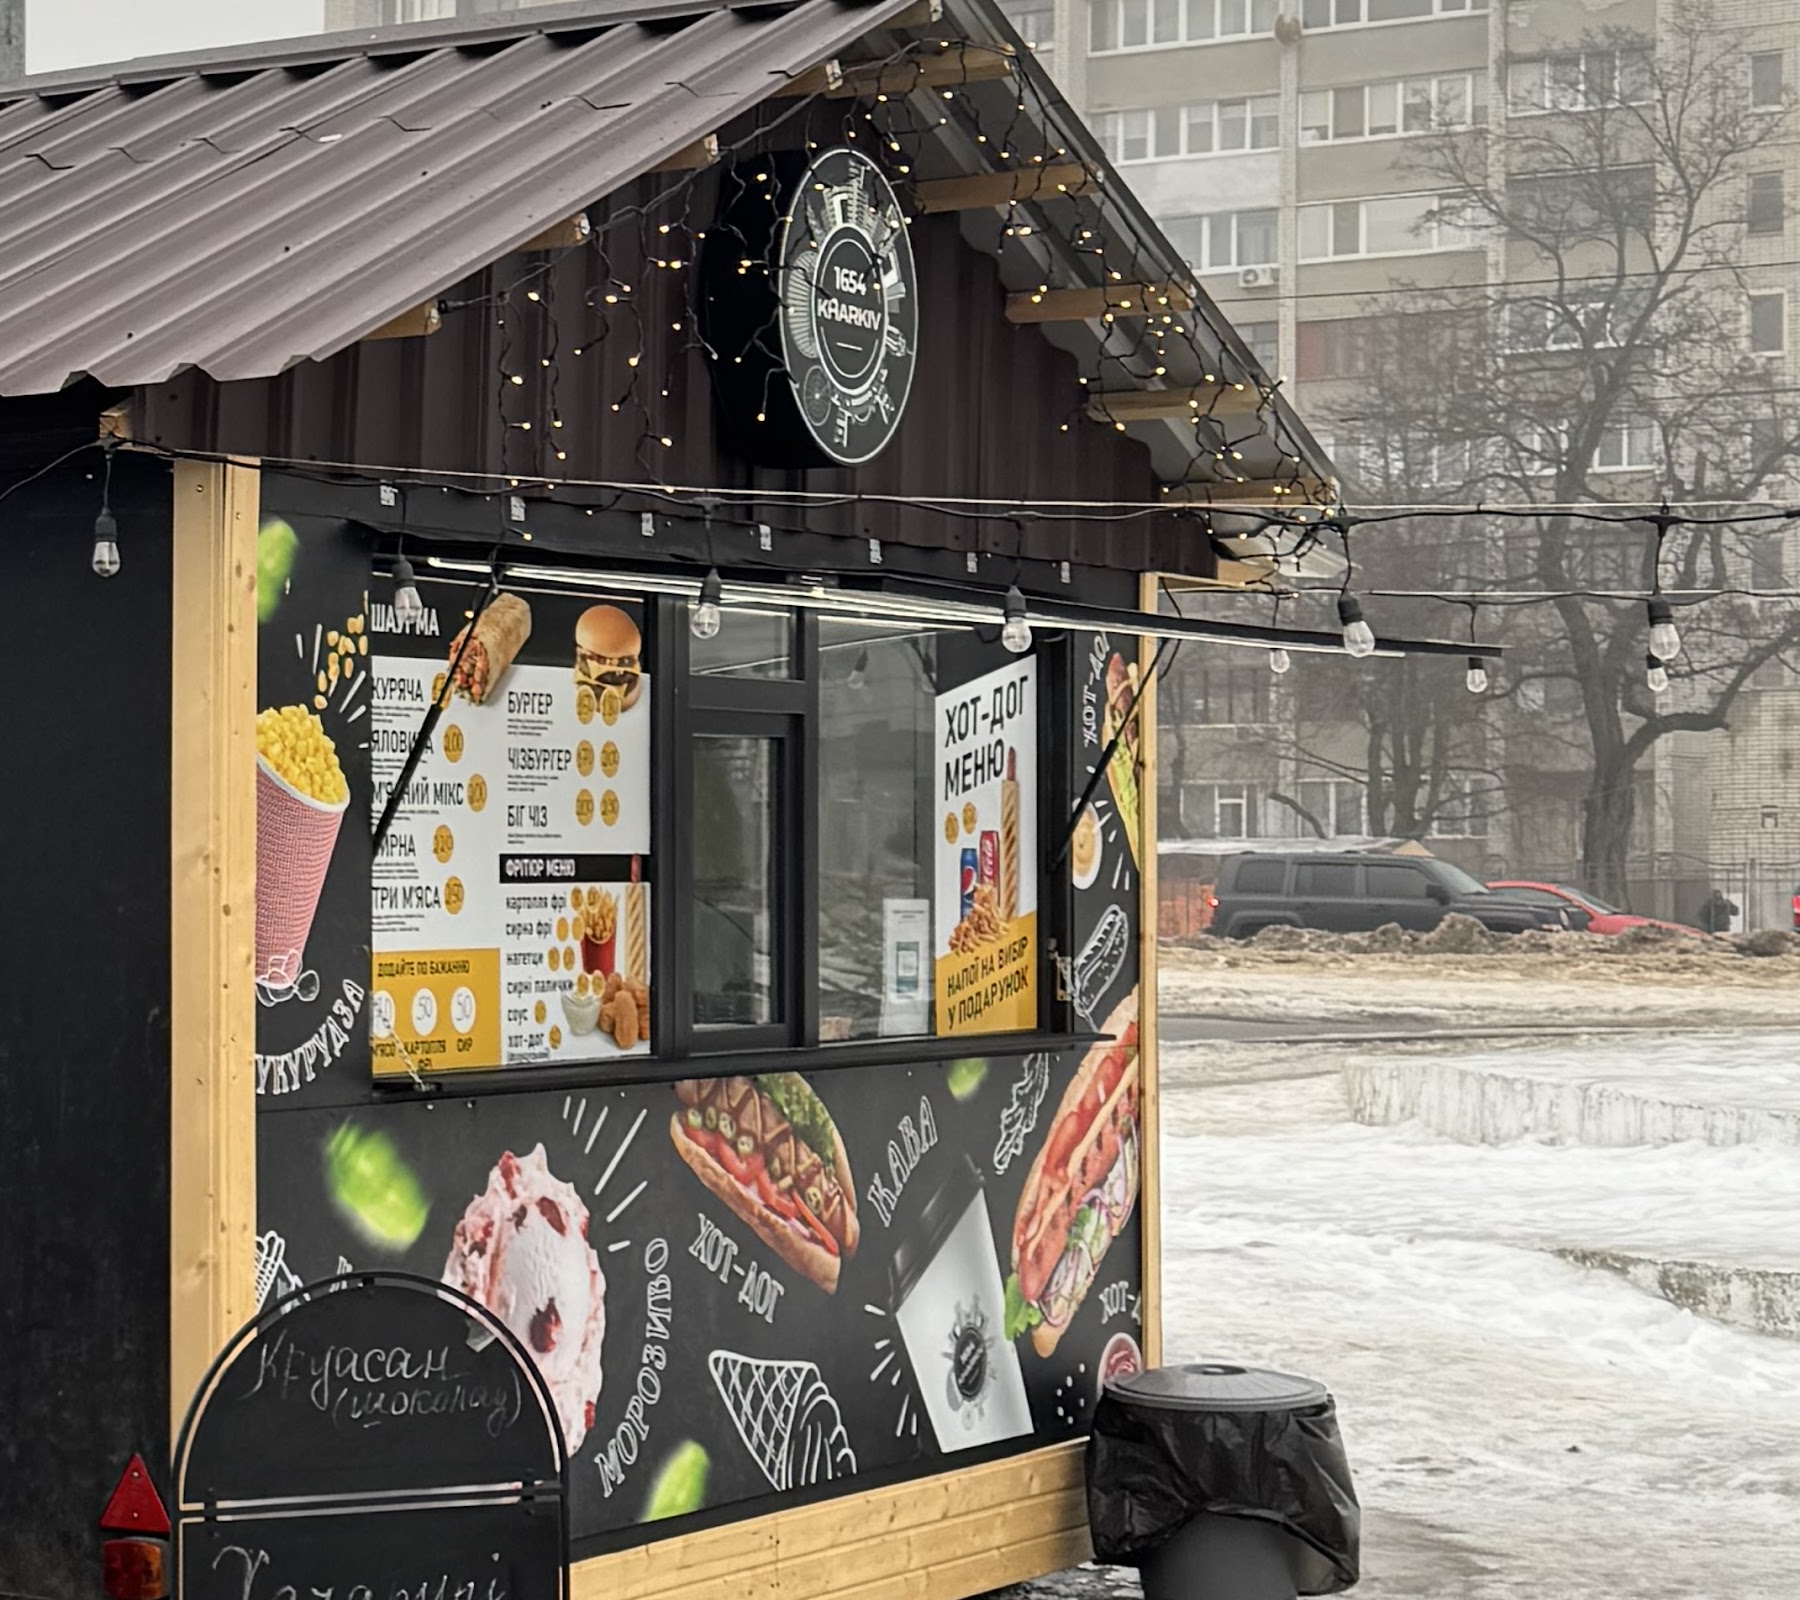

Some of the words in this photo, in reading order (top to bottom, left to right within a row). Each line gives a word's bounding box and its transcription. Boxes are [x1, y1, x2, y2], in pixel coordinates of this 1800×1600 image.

[834, 266, 867, 295] 1654
[373, 677, 423, 701] КУРЯЧА
[508, 691, 553, 714] БУРГЕР
[945, 675, 1028, 748] ХОТ-ДОГ
[372, 730, 434, 754] ЯЛОВИА
[508, 747, 572, 771] ЧІЗБУРГЕР
[945, 738, 1005, 801] МЕНЮ
[374, 777, 429, 805] М'ЯНИЙ
[434, 782, 464, 805] МІКС
[507, 805, 525, 827] БІГ
[529, 805, 548, 827] ЧІЗ
[380, 834, 416, 857] ИРНА
[546, 858, 576, 877] МЕНЮ
[371, 886, 398, 909] ТРИ
[402, 886, 441, 909] М'ЯСА
[947, 956, 979, 998] НАПОЇ
[982, 954, 995, 979] НА
[948, 1005, 956, 1030] У
[959, 965, 1028, 1024] ПОДАРУНОК
[255, 979, 365, 1094] УКУРУДЗА
[867, 1095, 938, 1227] КАВА
[688, 1212, 785, 1324] ХОТ-ДОГ
[594, 1238, 672, 1498] МОРОЗИВО
